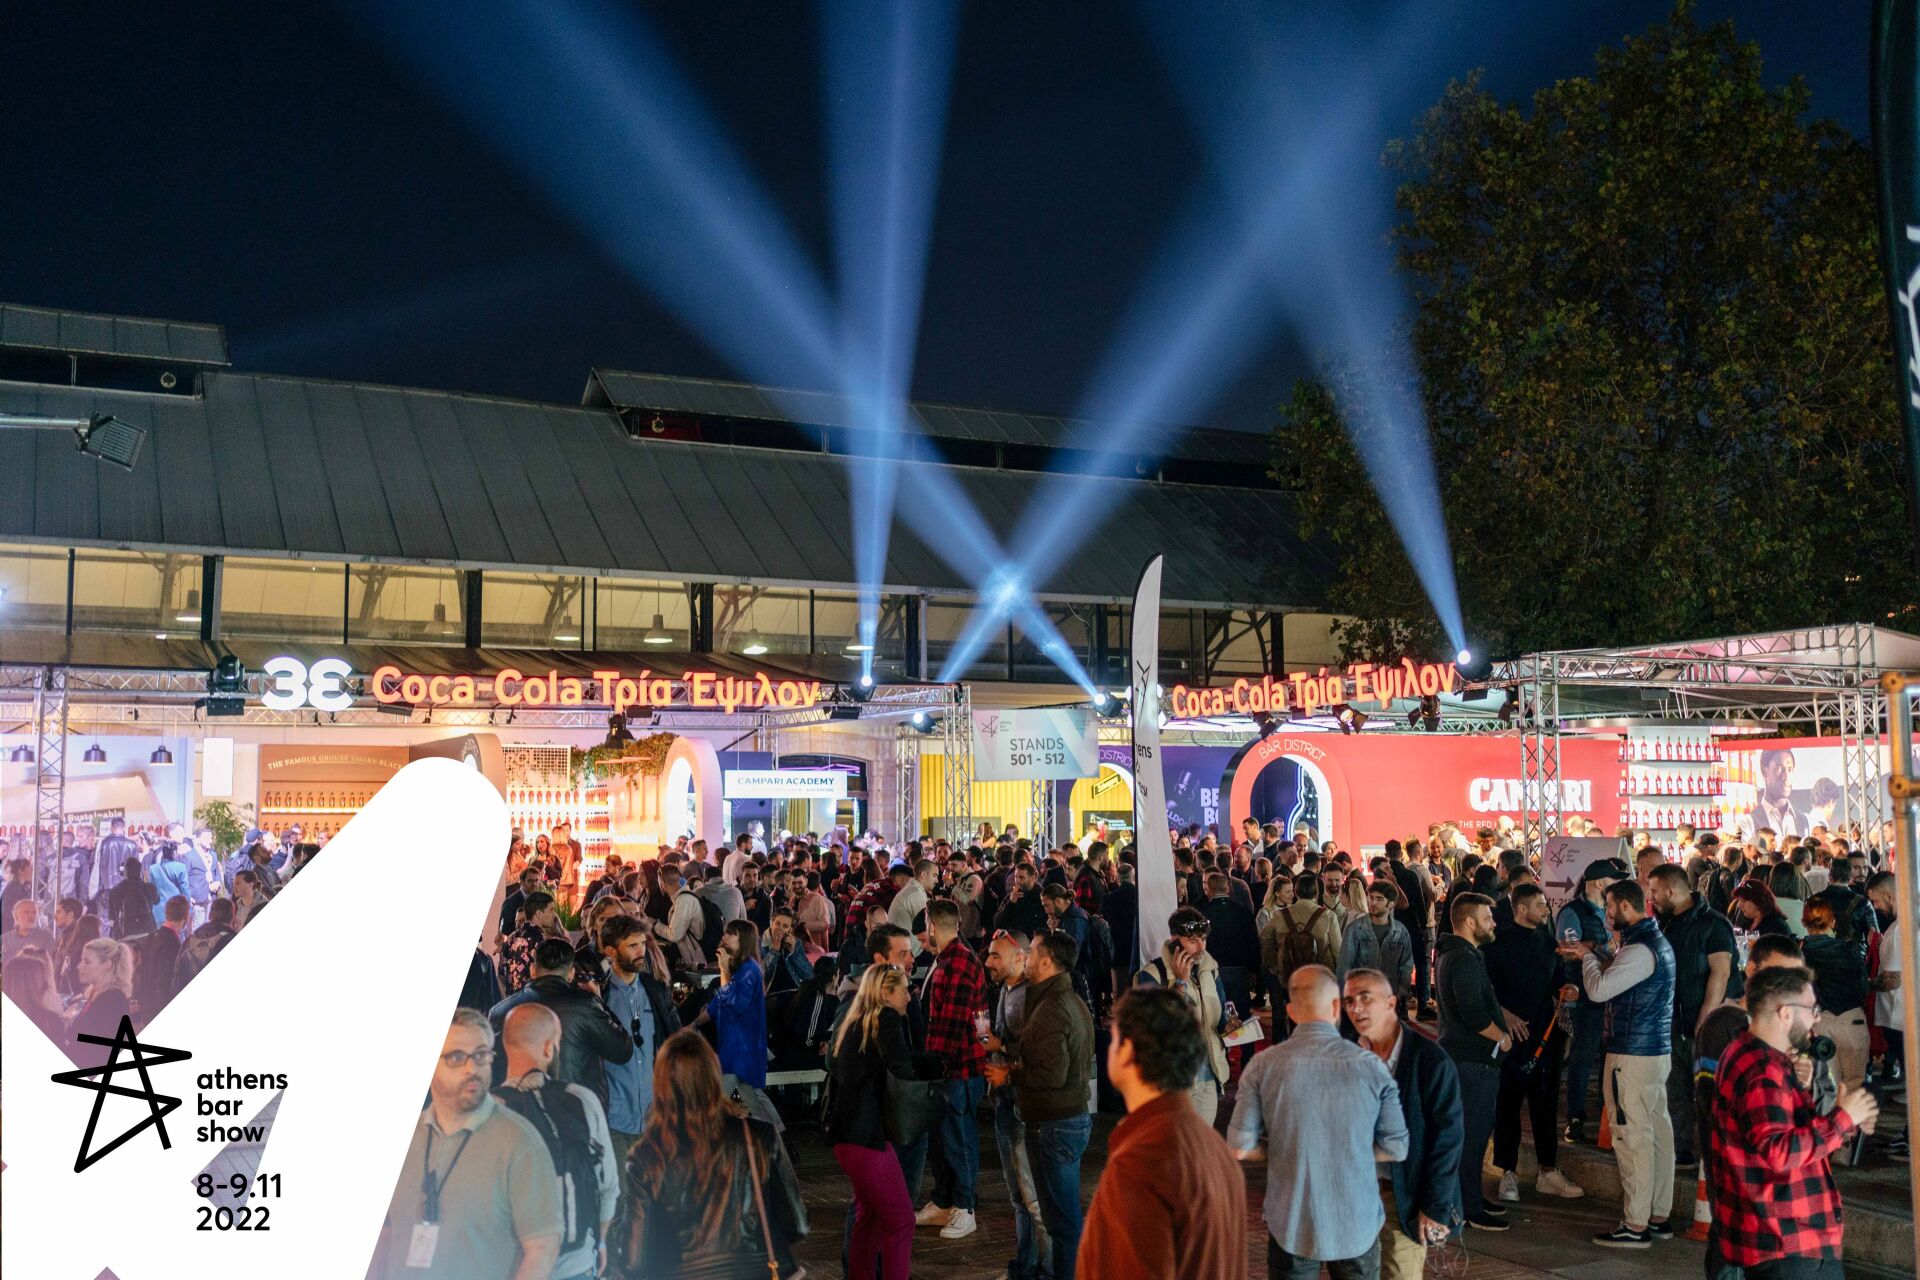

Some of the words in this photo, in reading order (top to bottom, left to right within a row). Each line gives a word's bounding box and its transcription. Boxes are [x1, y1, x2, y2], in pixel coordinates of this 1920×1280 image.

[372, 665, 583, 706] Coca-Cola
[1172, 675, 1286, 718] Coca-Cola
[1010, 738, 1064, 751] STANDS
[1259, 740, 1282, 760] BAR
[1284, 739, 1326, 762] DISTRICT
[1011, 754, 1032, 766] 501
[1045, 753, 1065, 765] 512
[786, 777, 835, 785] ACADEMY
